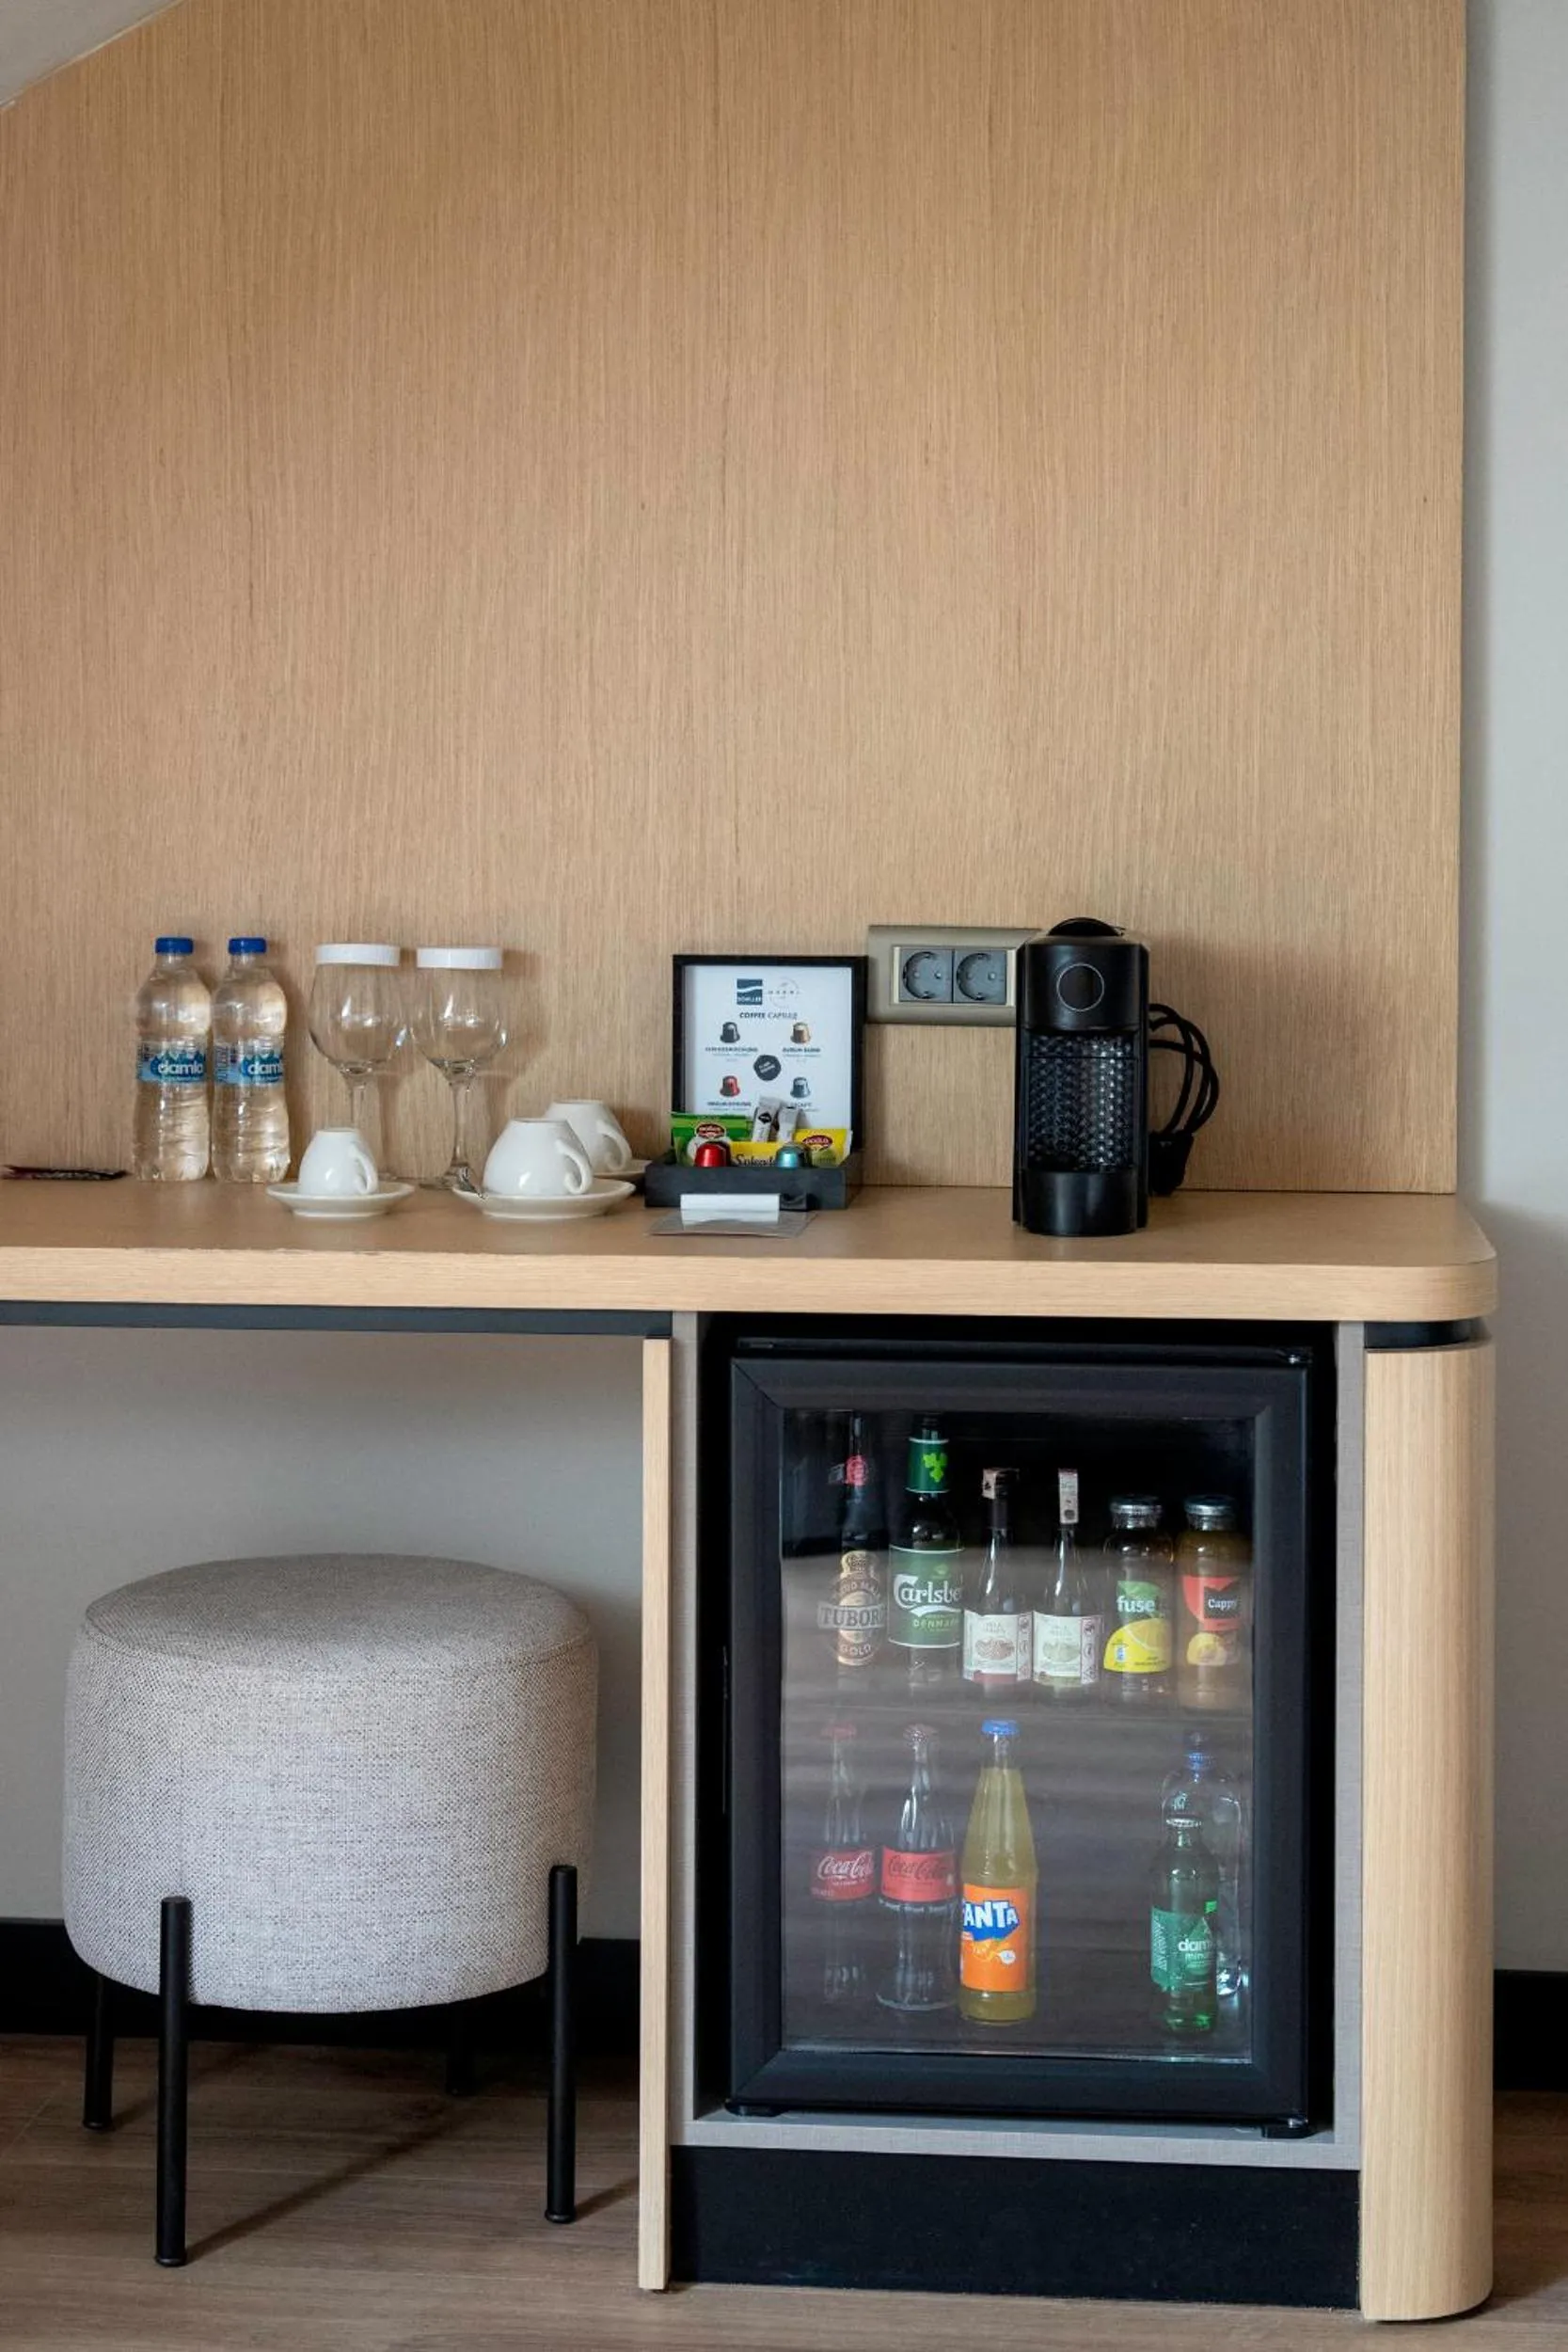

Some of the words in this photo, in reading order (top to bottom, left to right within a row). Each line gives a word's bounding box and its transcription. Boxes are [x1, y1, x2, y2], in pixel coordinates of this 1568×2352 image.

[247, 1060, 282, 1073] dam
[895, 1574, 961, 1610] Carlsbe
[1116, 1595, 1156, 1613] fuse
[819, 1605, 884, 1627] TUBOR
[962, 1900, 1019, 1929] ANTA
